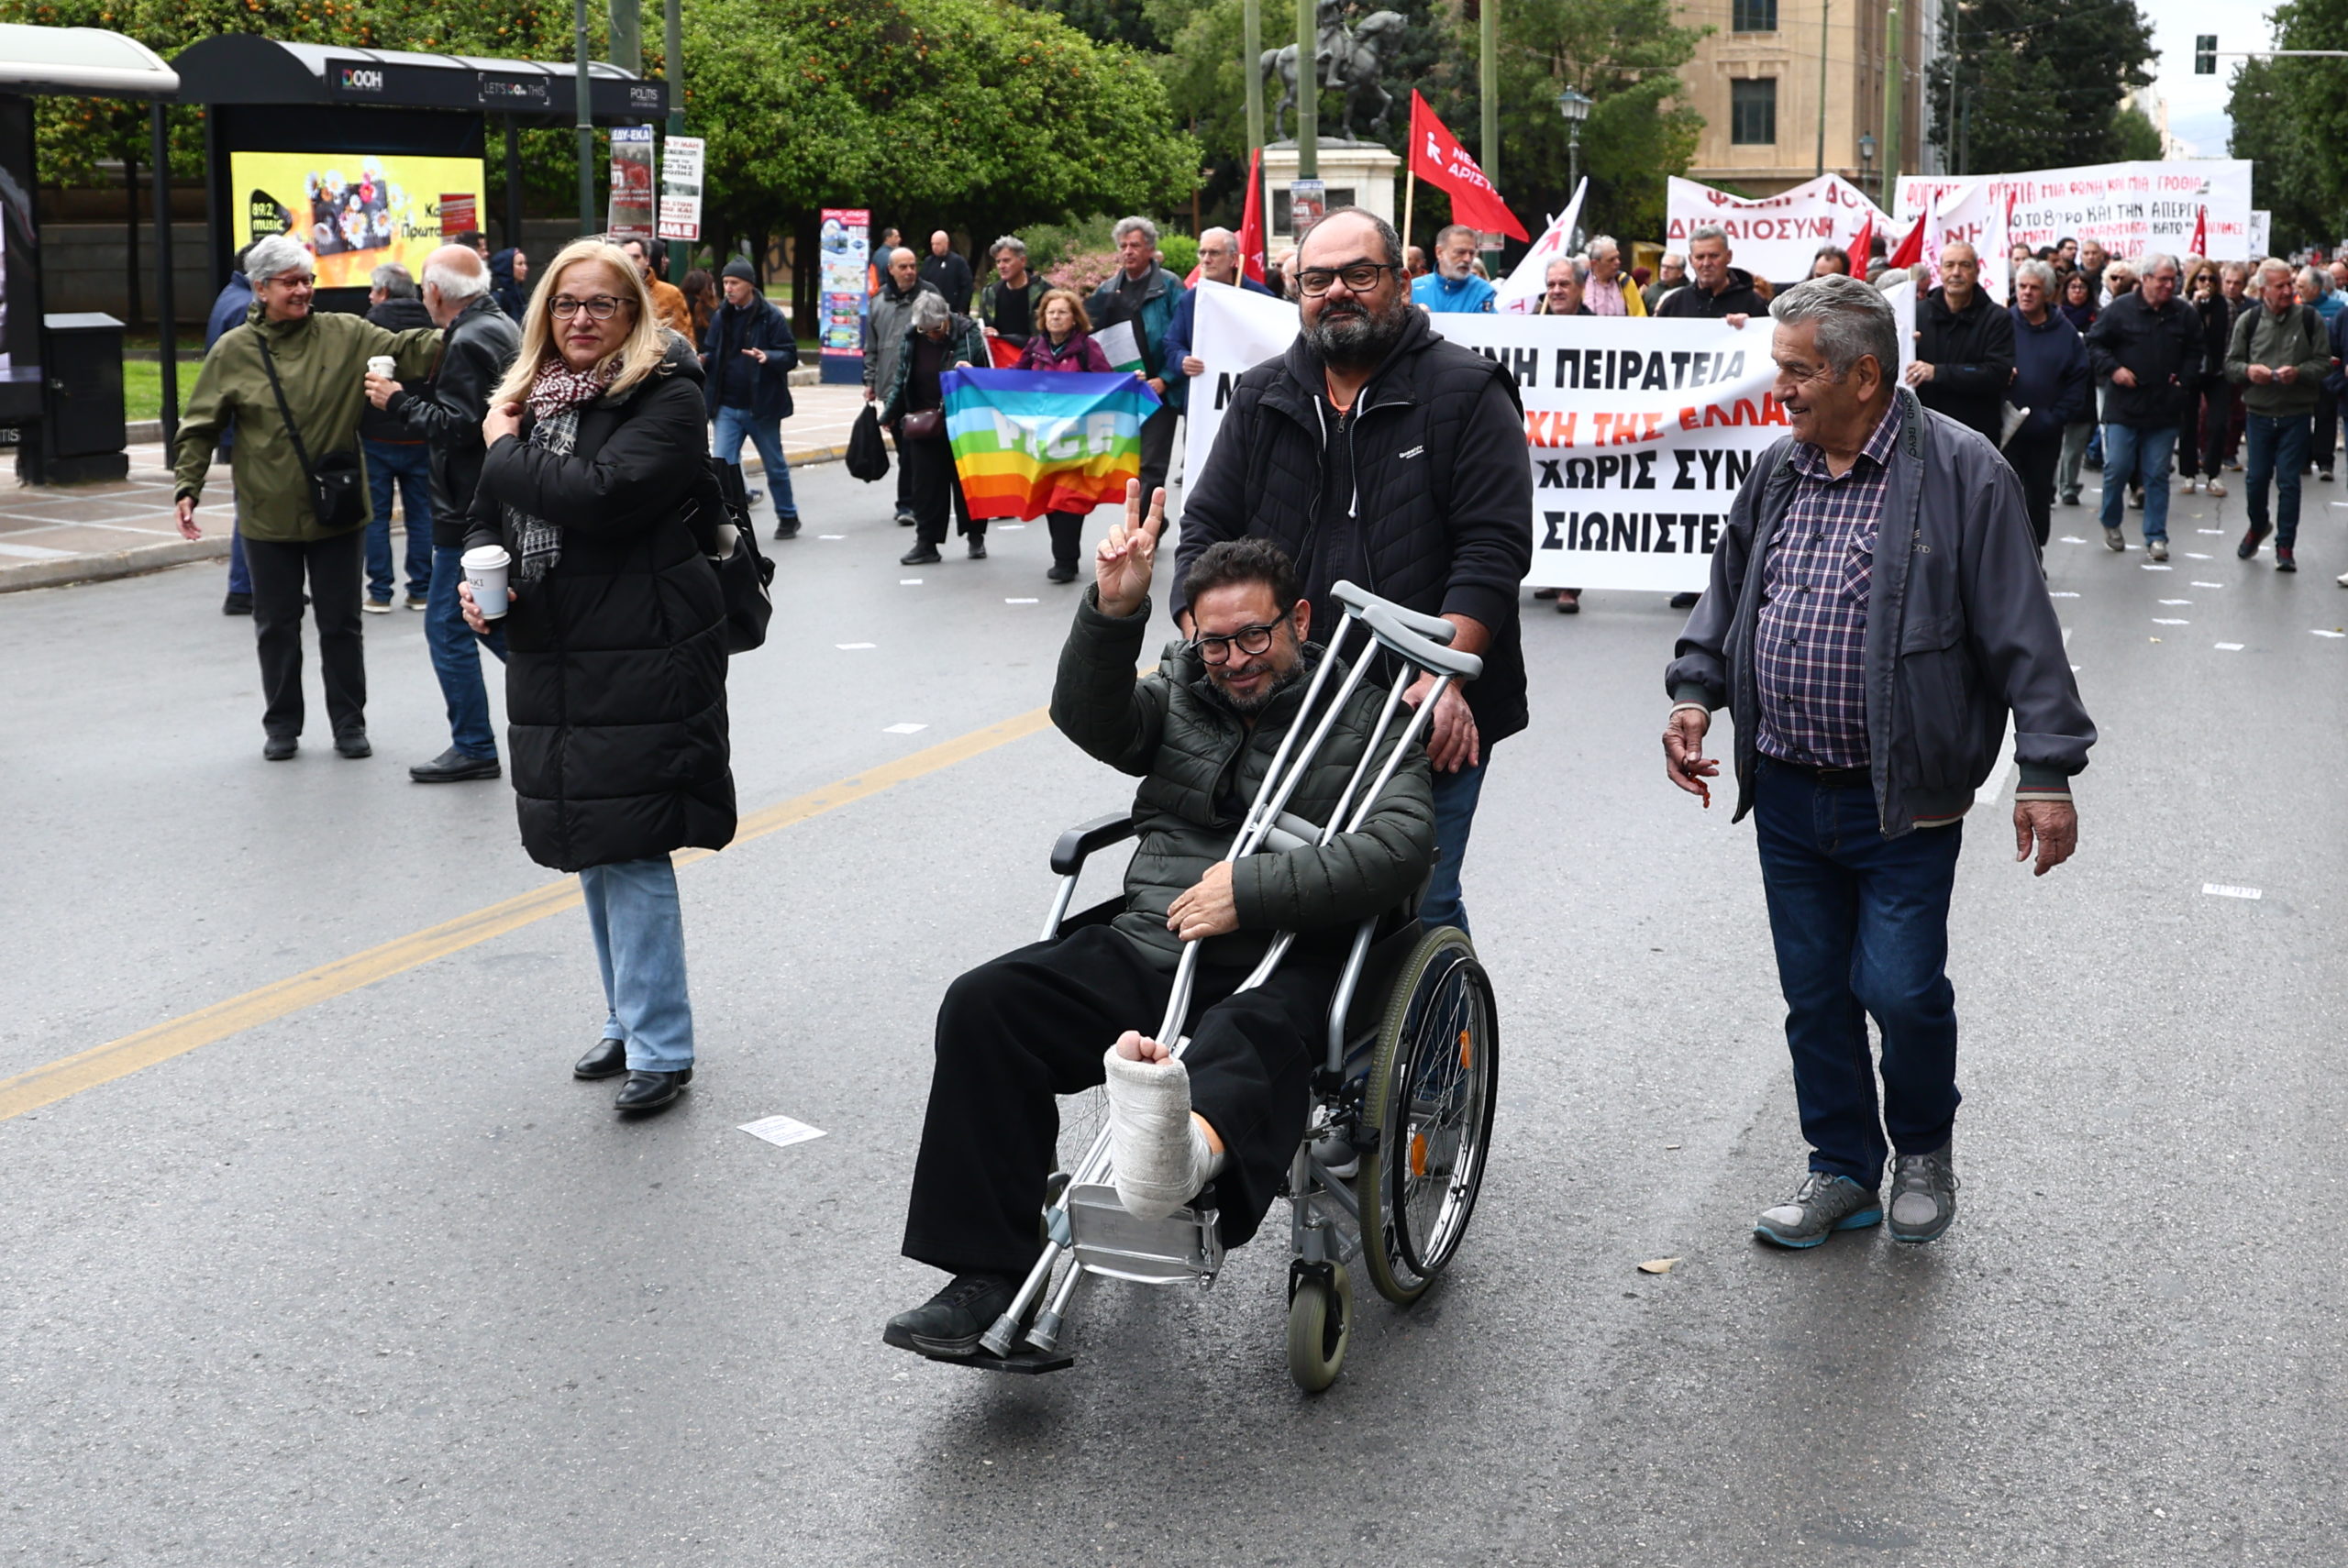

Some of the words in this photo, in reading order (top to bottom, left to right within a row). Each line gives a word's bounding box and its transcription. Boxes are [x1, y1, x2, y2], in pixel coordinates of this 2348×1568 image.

[342, 69, 383, 87] DOOH
[483, 82, 506, 94] LET'S
[527, 84, 546, 96] THIS
[630, 87, 659, 100] POLITIS
[1452, 147, 1482, 171] ΝΕ
[2042, 183, 2066, 198] ΜΙΑ
[2070, 180, 2104, 195] ΦΩΝΗ
[2108, 177, 2124, 191] ΚΑΙ
[252, 203, 274, 216] 89.2
[2088, 204, 2111, 222] ΚΑΙ
[2117, 203, 2143, 219] ΤΗΝ
[2153, 221, 2182, 235] ΚΑΤΩ
[1555, 348, 1745, 391] ΠΕΙΡΑΤΕΙΑ
[1592, 412, 1665, 447] ΤΗΣ
[1678, 391, 1792, 432] ΕΛΛΑ
[1535, 449, 1657, 490] ΧΩΡΙΣ
[1671, 448, 1752, 490] ΣΥΝ
[1540, 511, 1730, 554] ΣΙΩΝΙΣΤΕ
